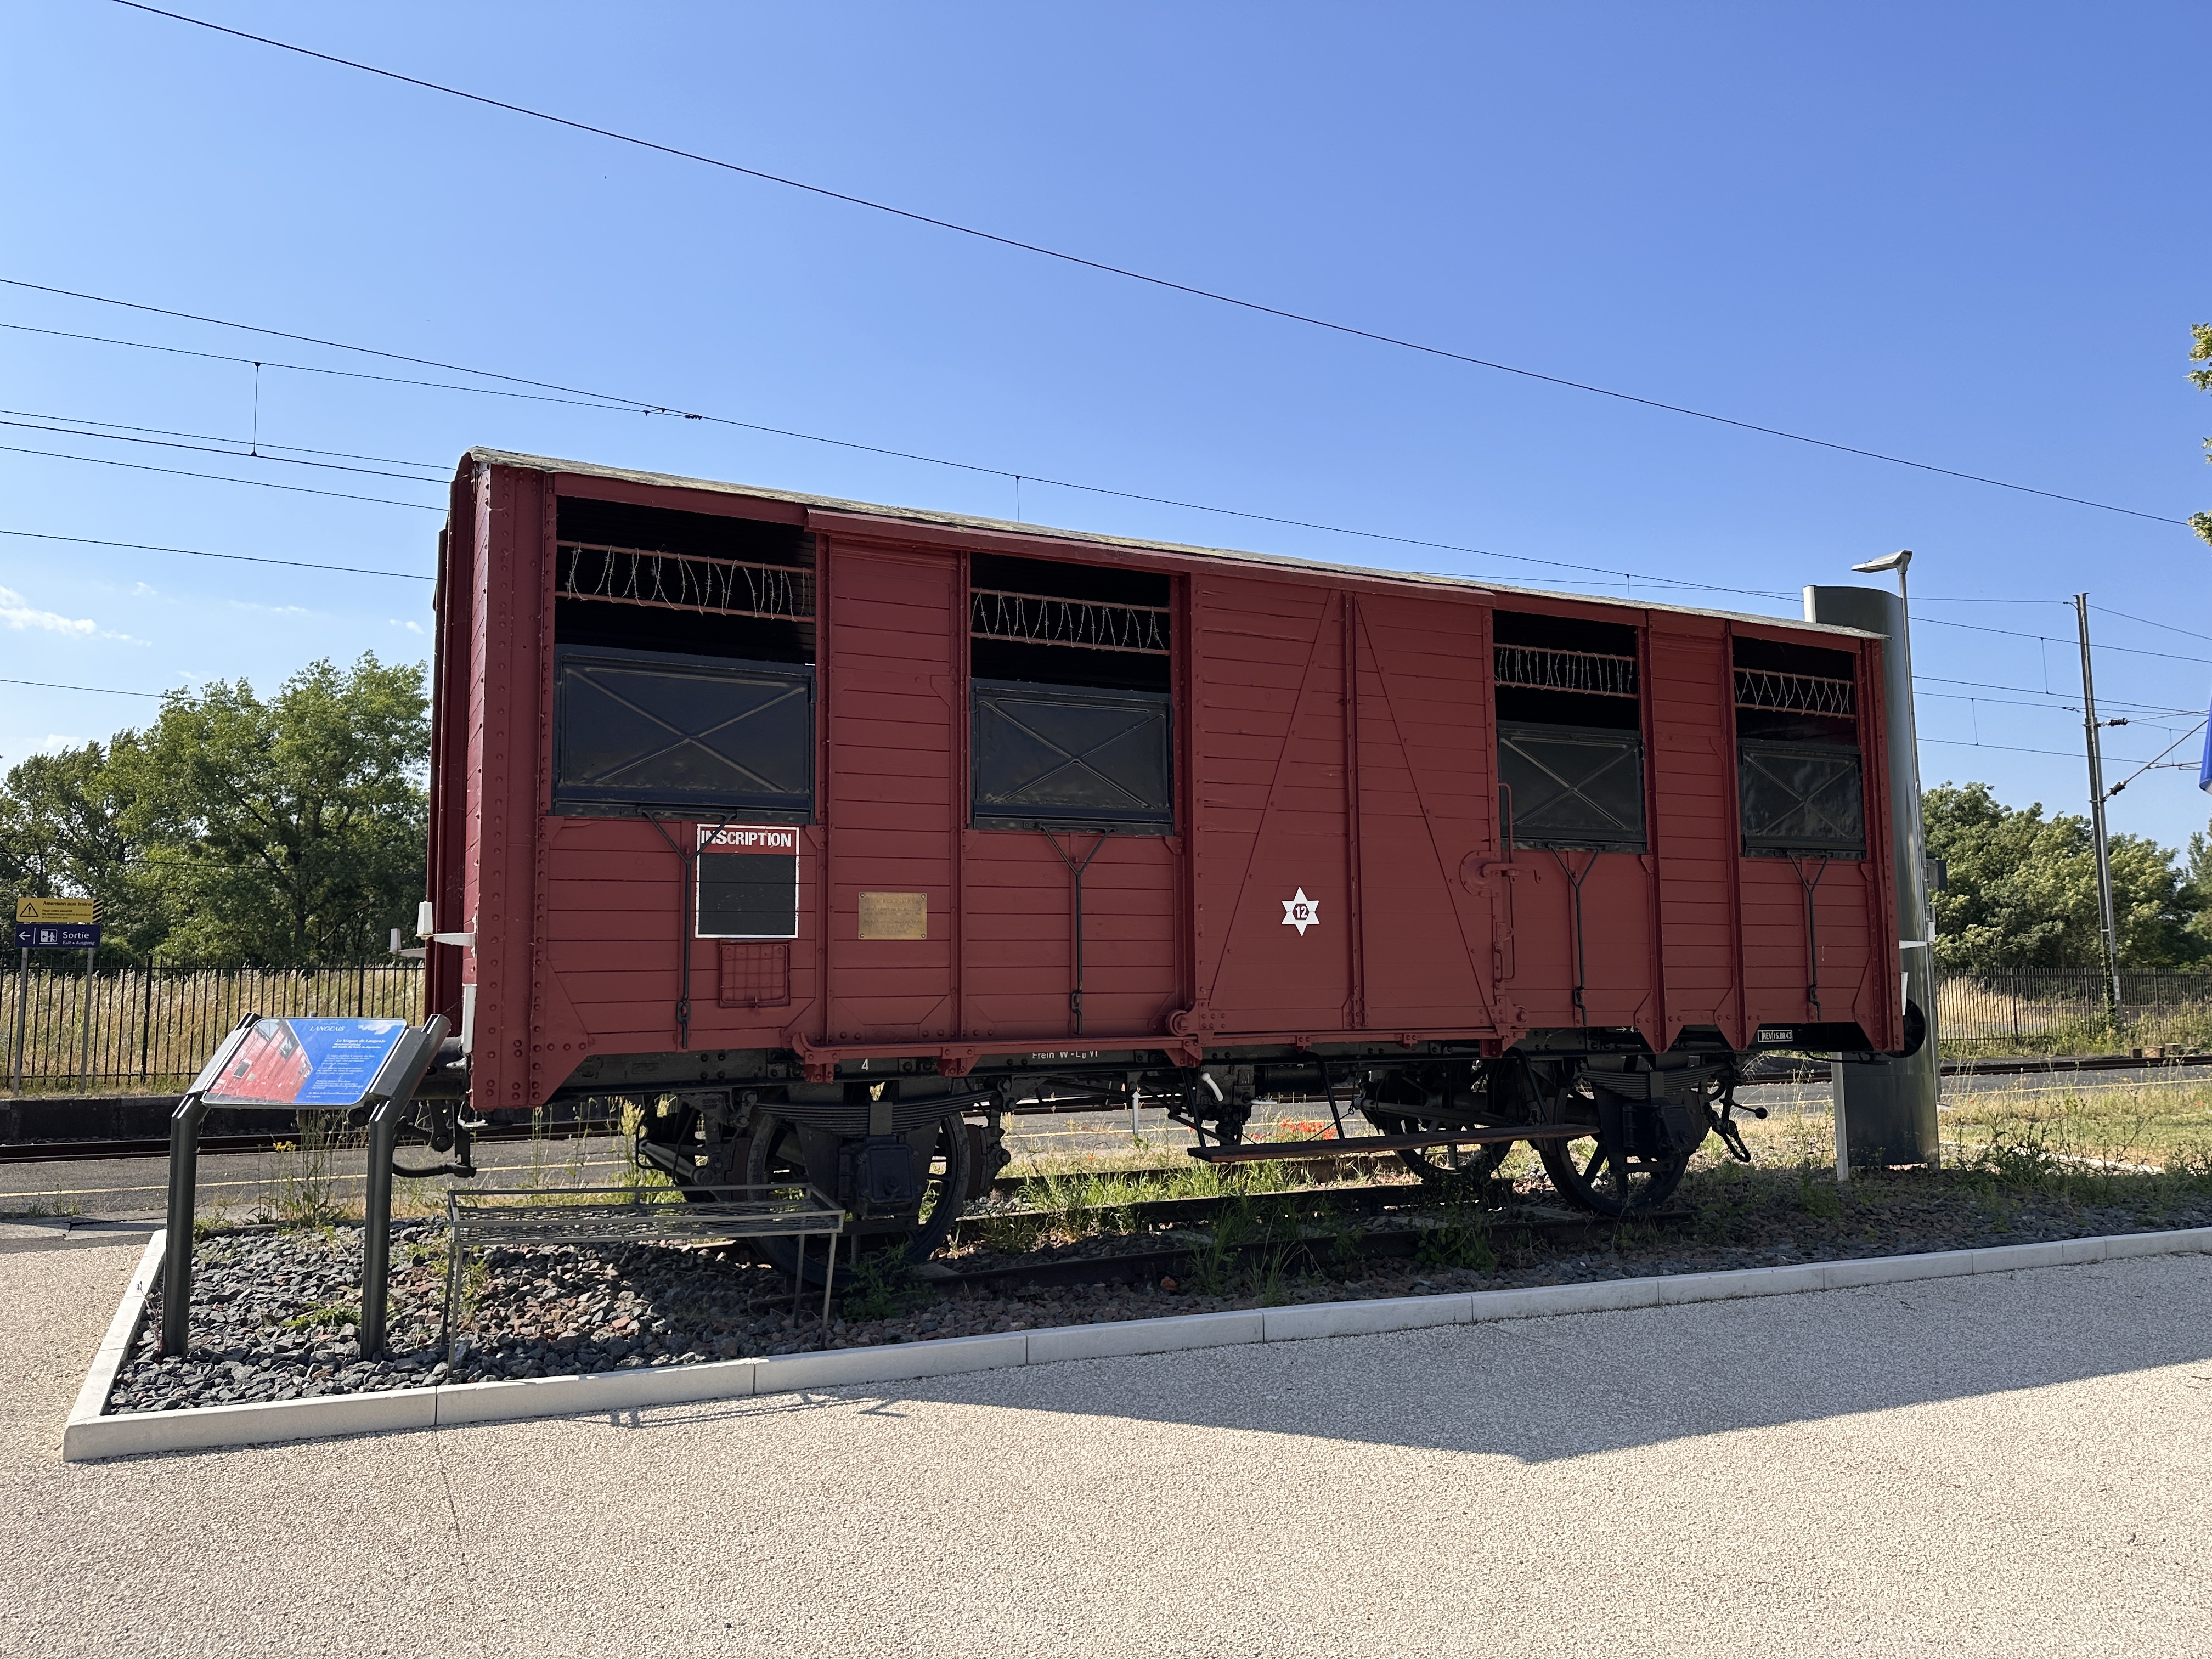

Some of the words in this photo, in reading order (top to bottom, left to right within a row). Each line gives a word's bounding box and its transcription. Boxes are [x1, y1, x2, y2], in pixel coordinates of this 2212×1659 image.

[701, 830, 791, 847] INSCRIPTION
[1295, 906, 1307, 918] 12
[861, 1058, 869, 1071] 4
